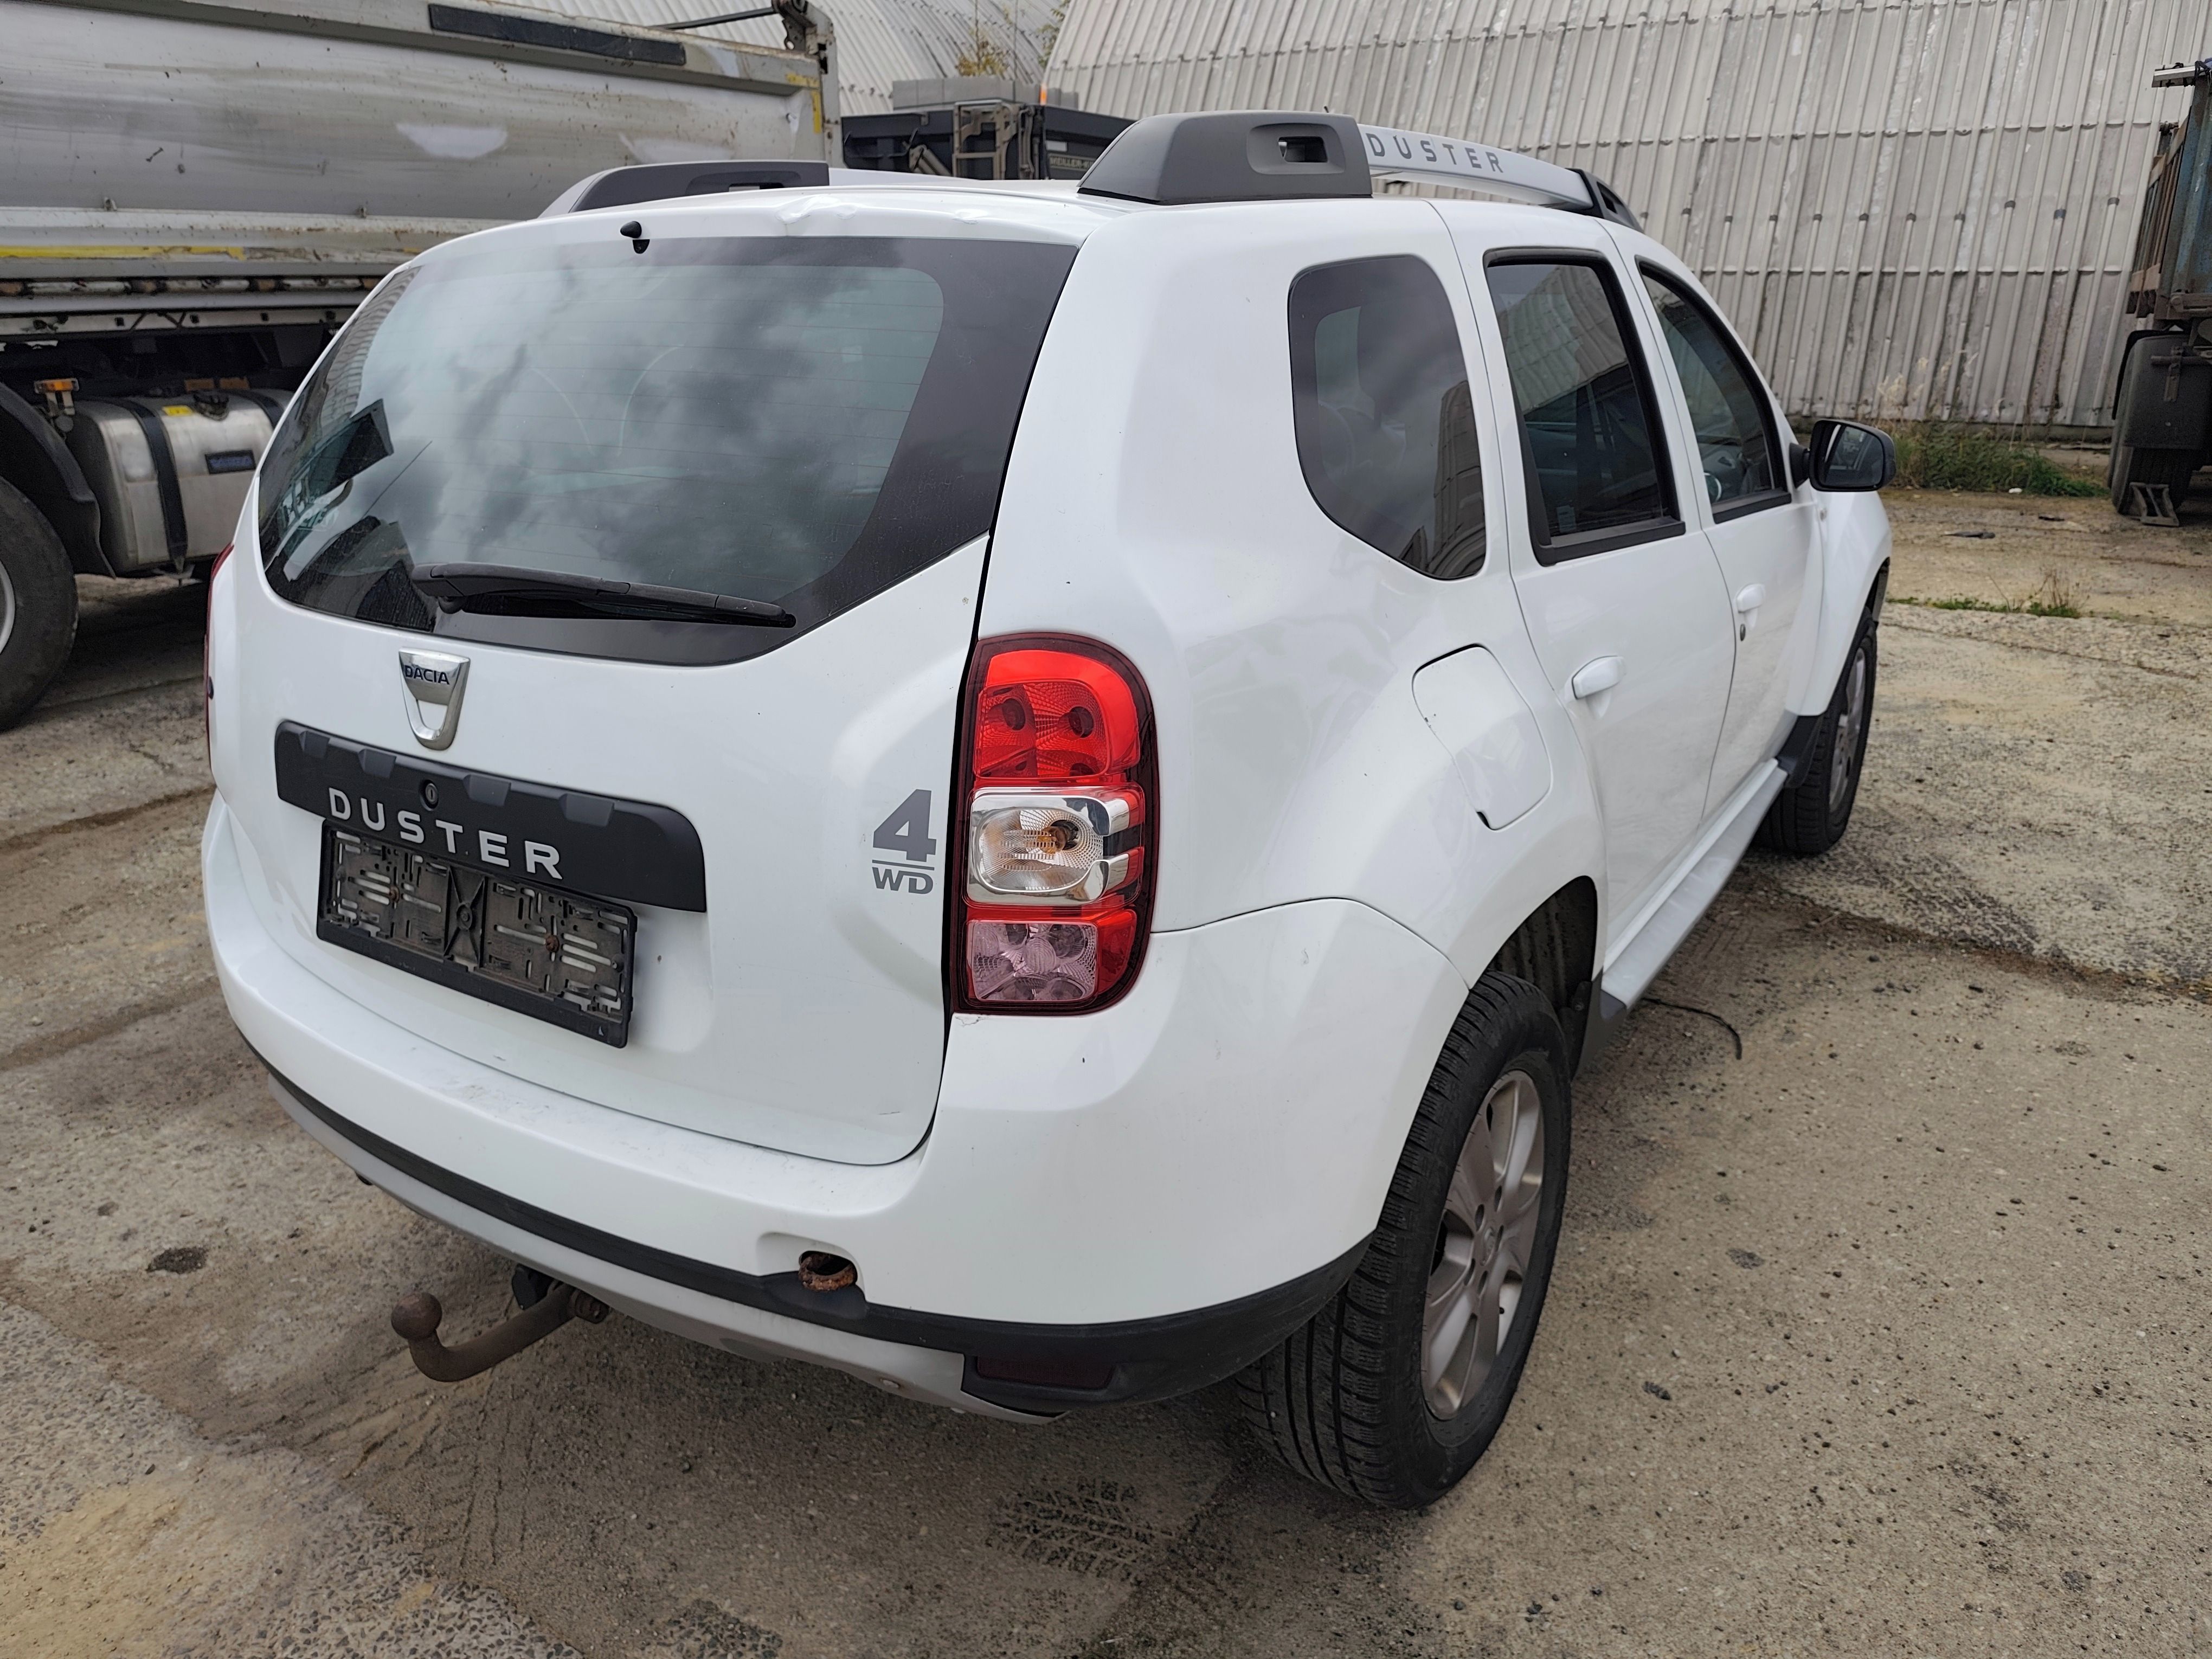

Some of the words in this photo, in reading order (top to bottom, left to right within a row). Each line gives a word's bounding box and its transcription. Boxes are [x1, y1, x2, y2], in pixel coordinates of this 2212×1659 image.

[1366, 133, 1503, 173] DUSTER
[404, 665, 450, 685] DACIA
[329, 787, 563, 879] DUSTER
[873, 789, 937, 862] 4
[872, 866, 934, 895] WD
